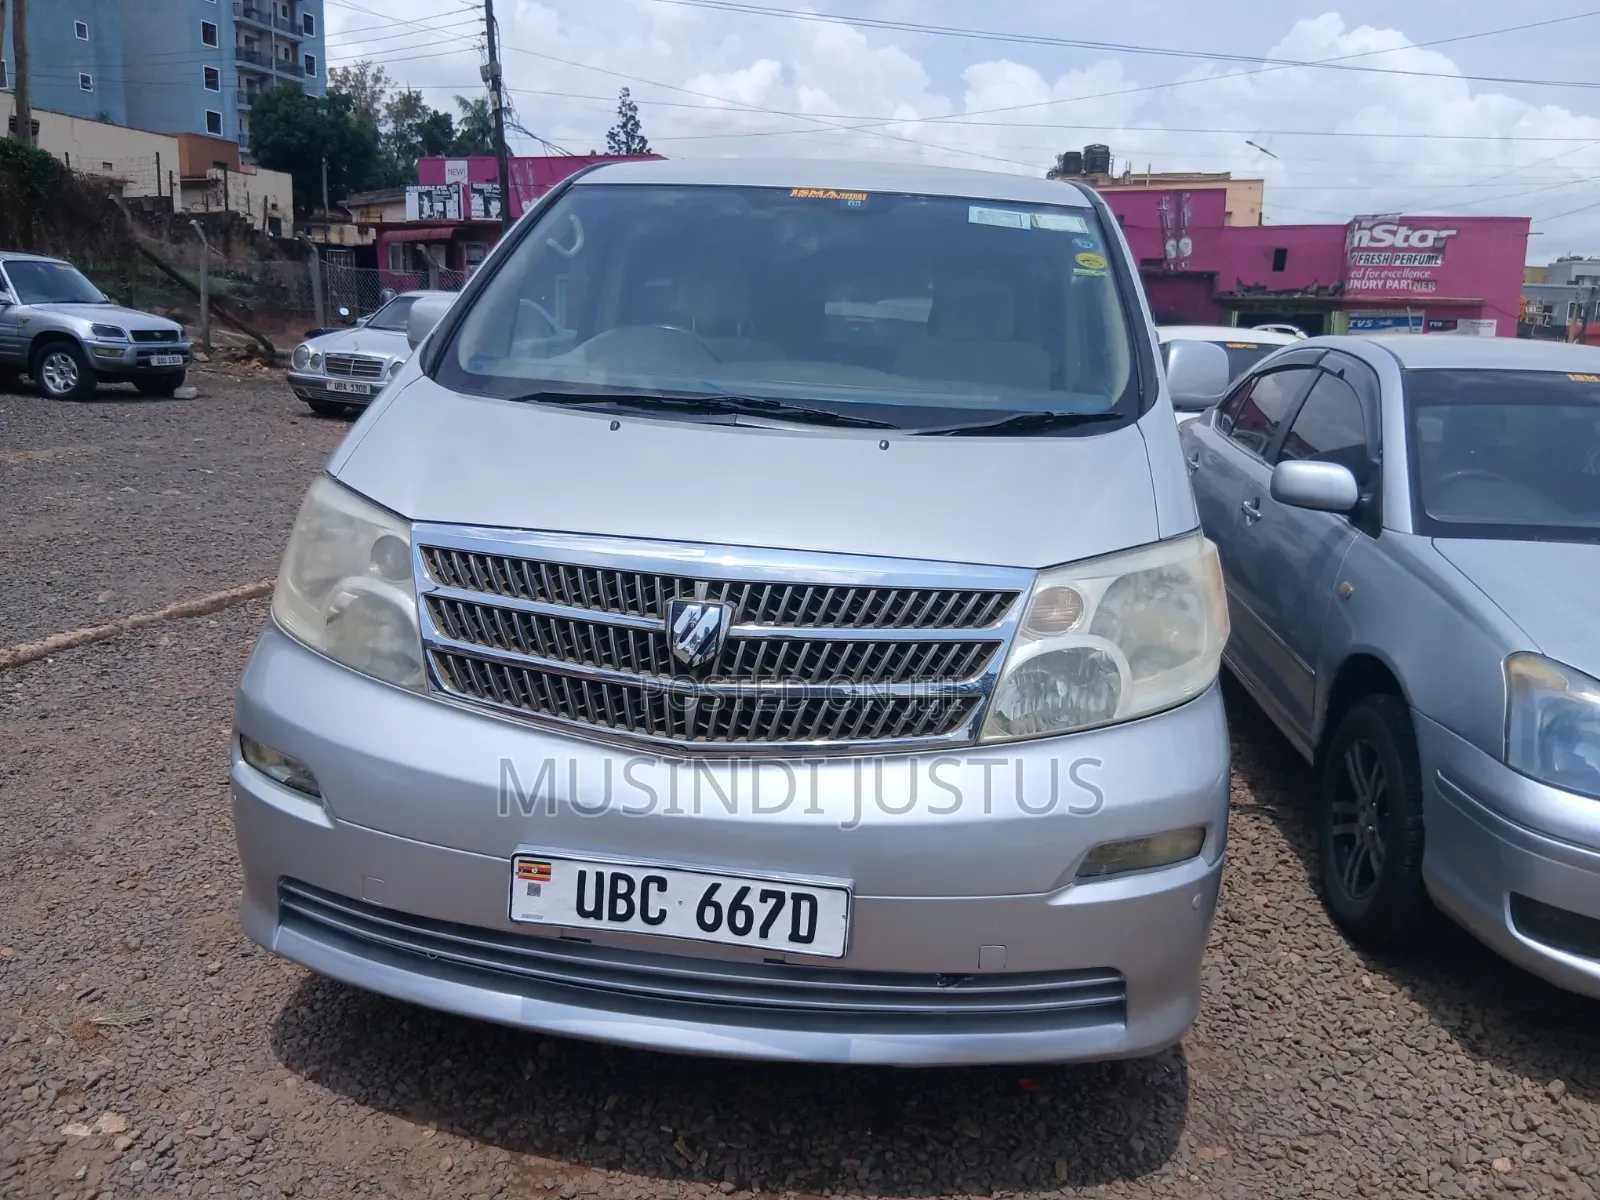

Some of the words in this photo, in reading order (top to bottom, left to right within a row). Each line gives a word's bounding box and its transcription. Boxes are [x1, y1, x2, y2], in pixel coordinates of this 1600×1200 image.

[1359, 253, 1390, 265] FRESH
[1393, 254, 1441, 265] PERFUME
[1364, 268, 1379, 280] for
[1381, 268, 1431, 278] excellence
[576, 869, 668, 925] UBC
[696, 884, 818, 944] 667D
